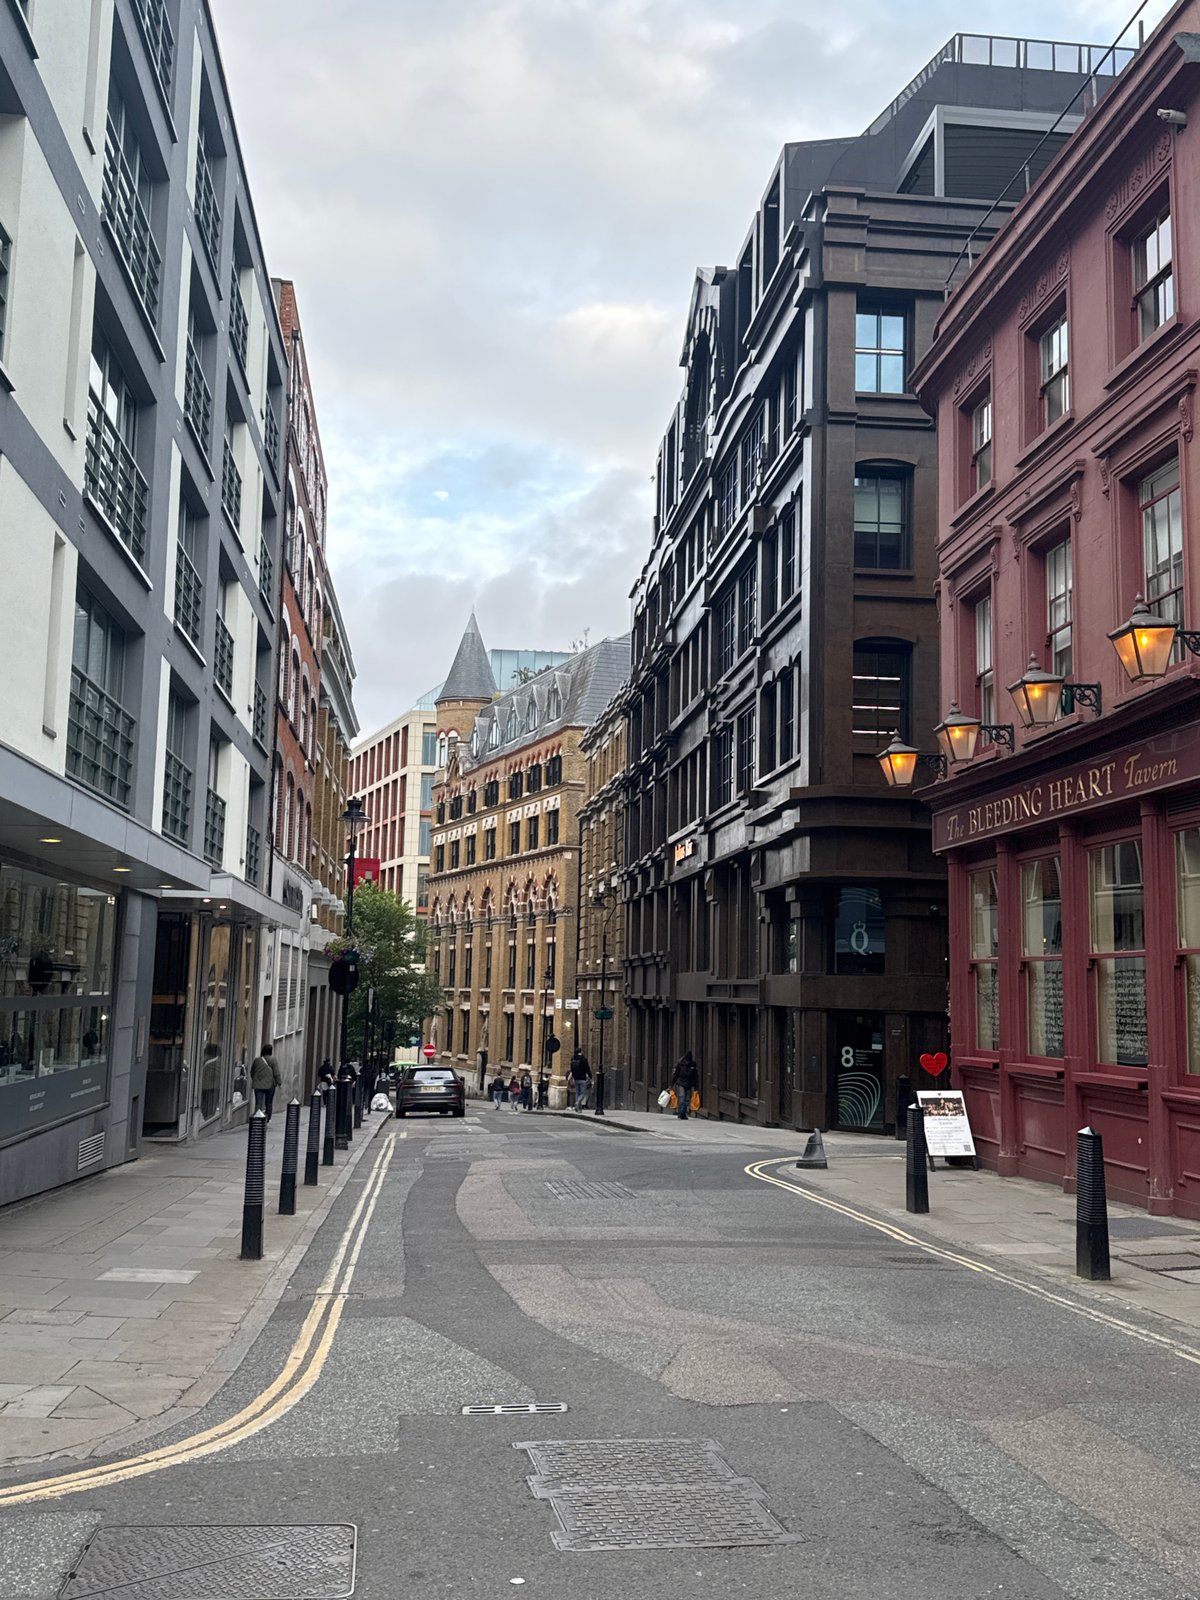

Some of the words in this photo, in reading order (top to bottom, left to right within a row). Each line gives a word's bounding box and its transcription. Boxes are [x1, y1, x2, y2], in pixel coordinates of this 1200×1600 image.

[947, 814, 964, 841] The
[968, 787, 1042, 835] BLEEDING
[1048, 762, 1116, 812] HEART
[1123, 752, 1178, 789] Tavern
[841, 1046, 855, 1068] 8
